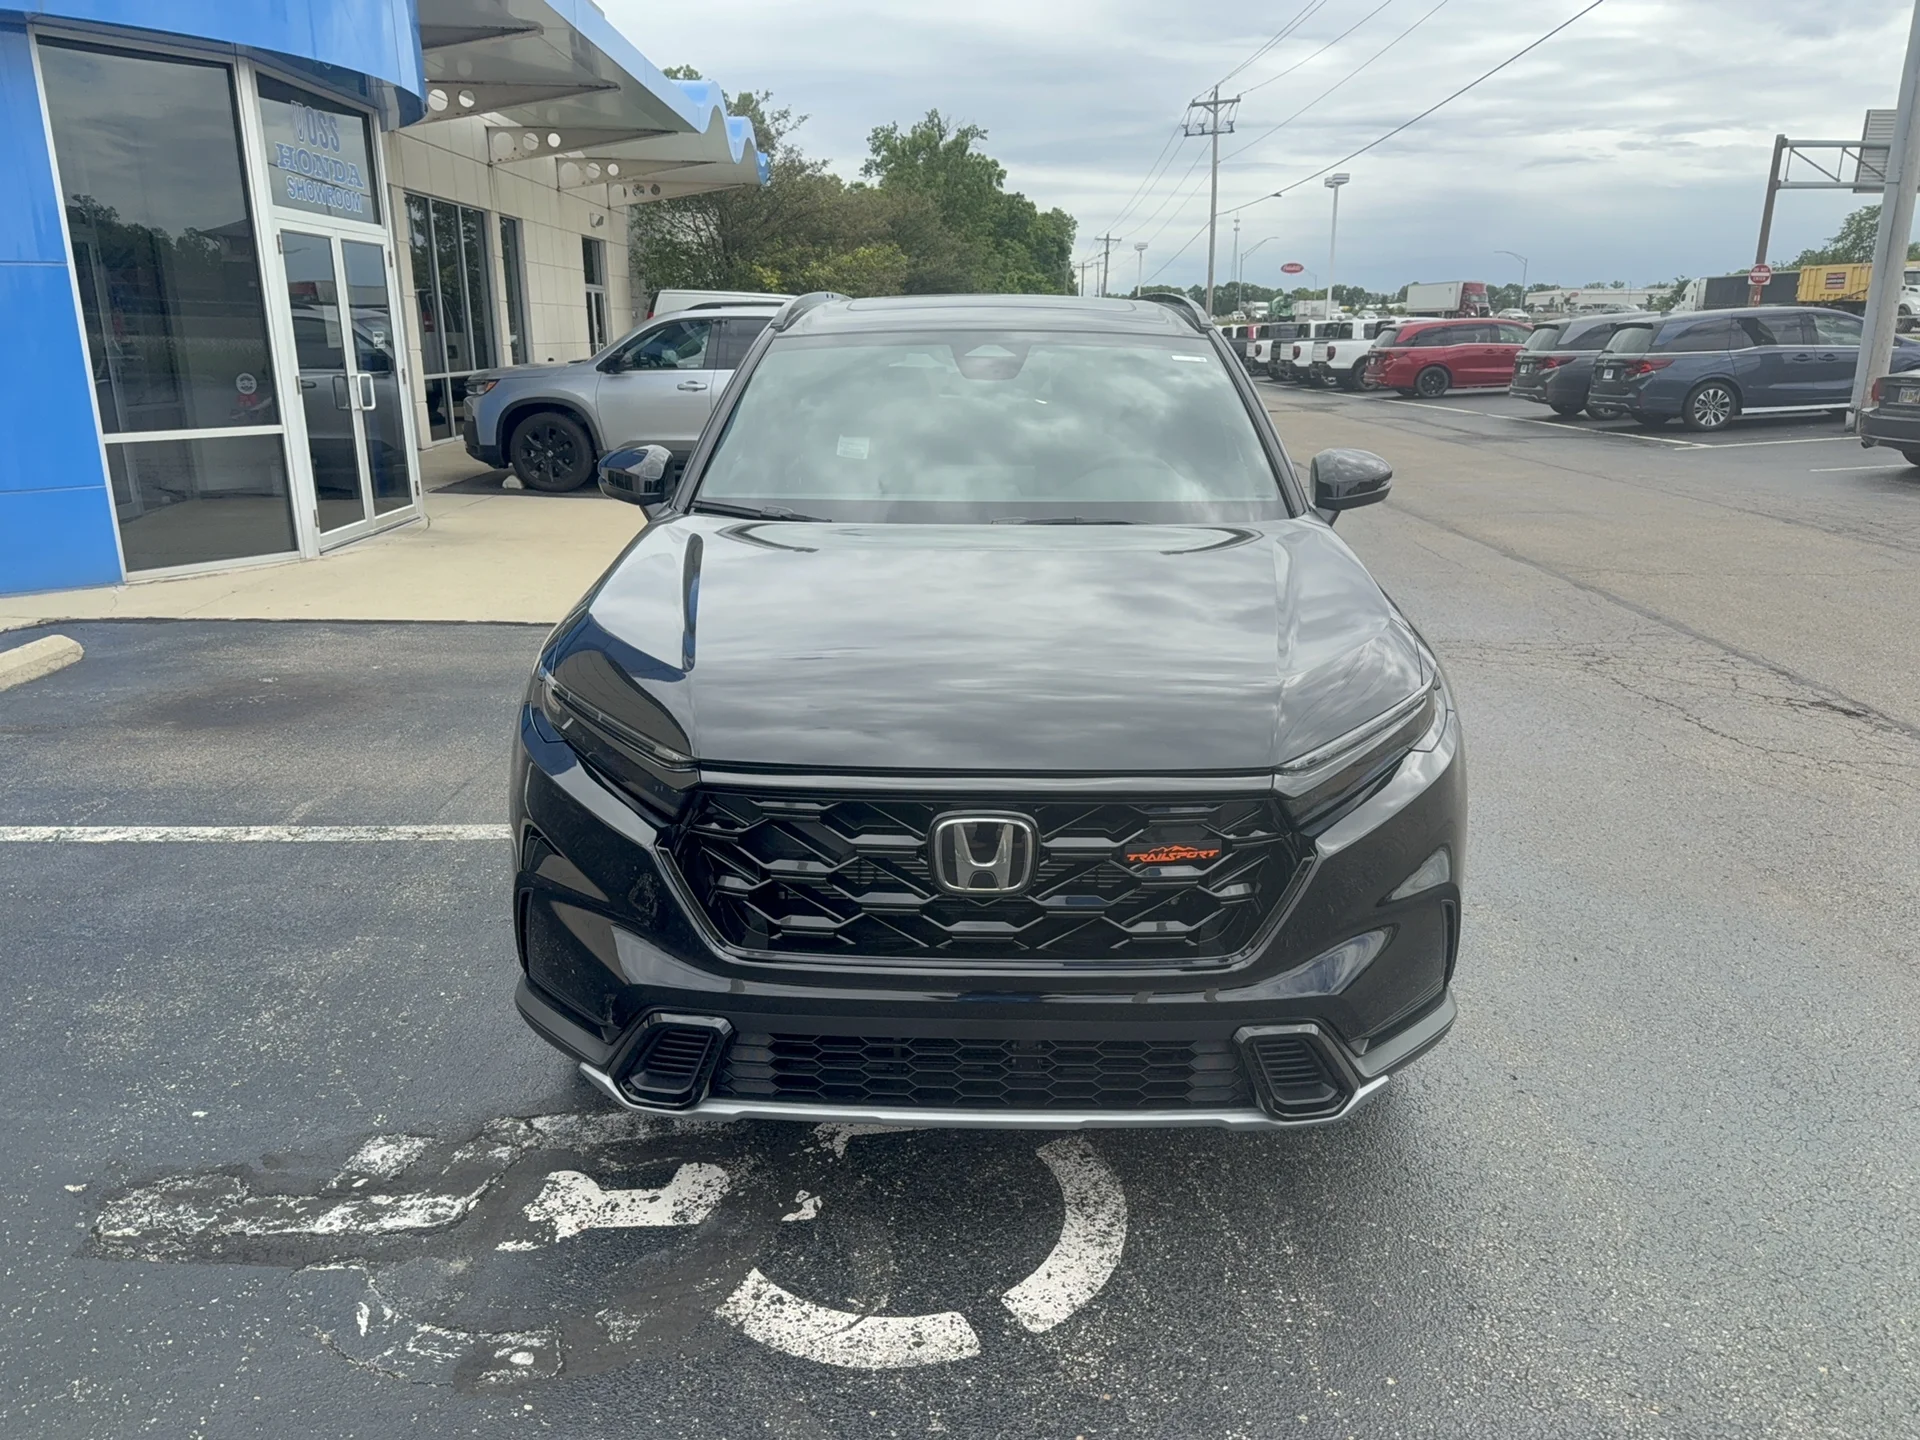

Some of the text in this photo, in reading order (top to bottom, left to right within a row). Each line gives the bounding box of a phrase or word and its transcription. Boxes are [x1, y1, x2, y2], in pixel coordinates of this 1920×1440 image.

[291, 100, 341, 153] VOSS
[275, 141, 365, 190] HONDA
[286, 175, 363, 213] SHOWROOM
[1126, 849, 1220, 863] TRAILSPORT
